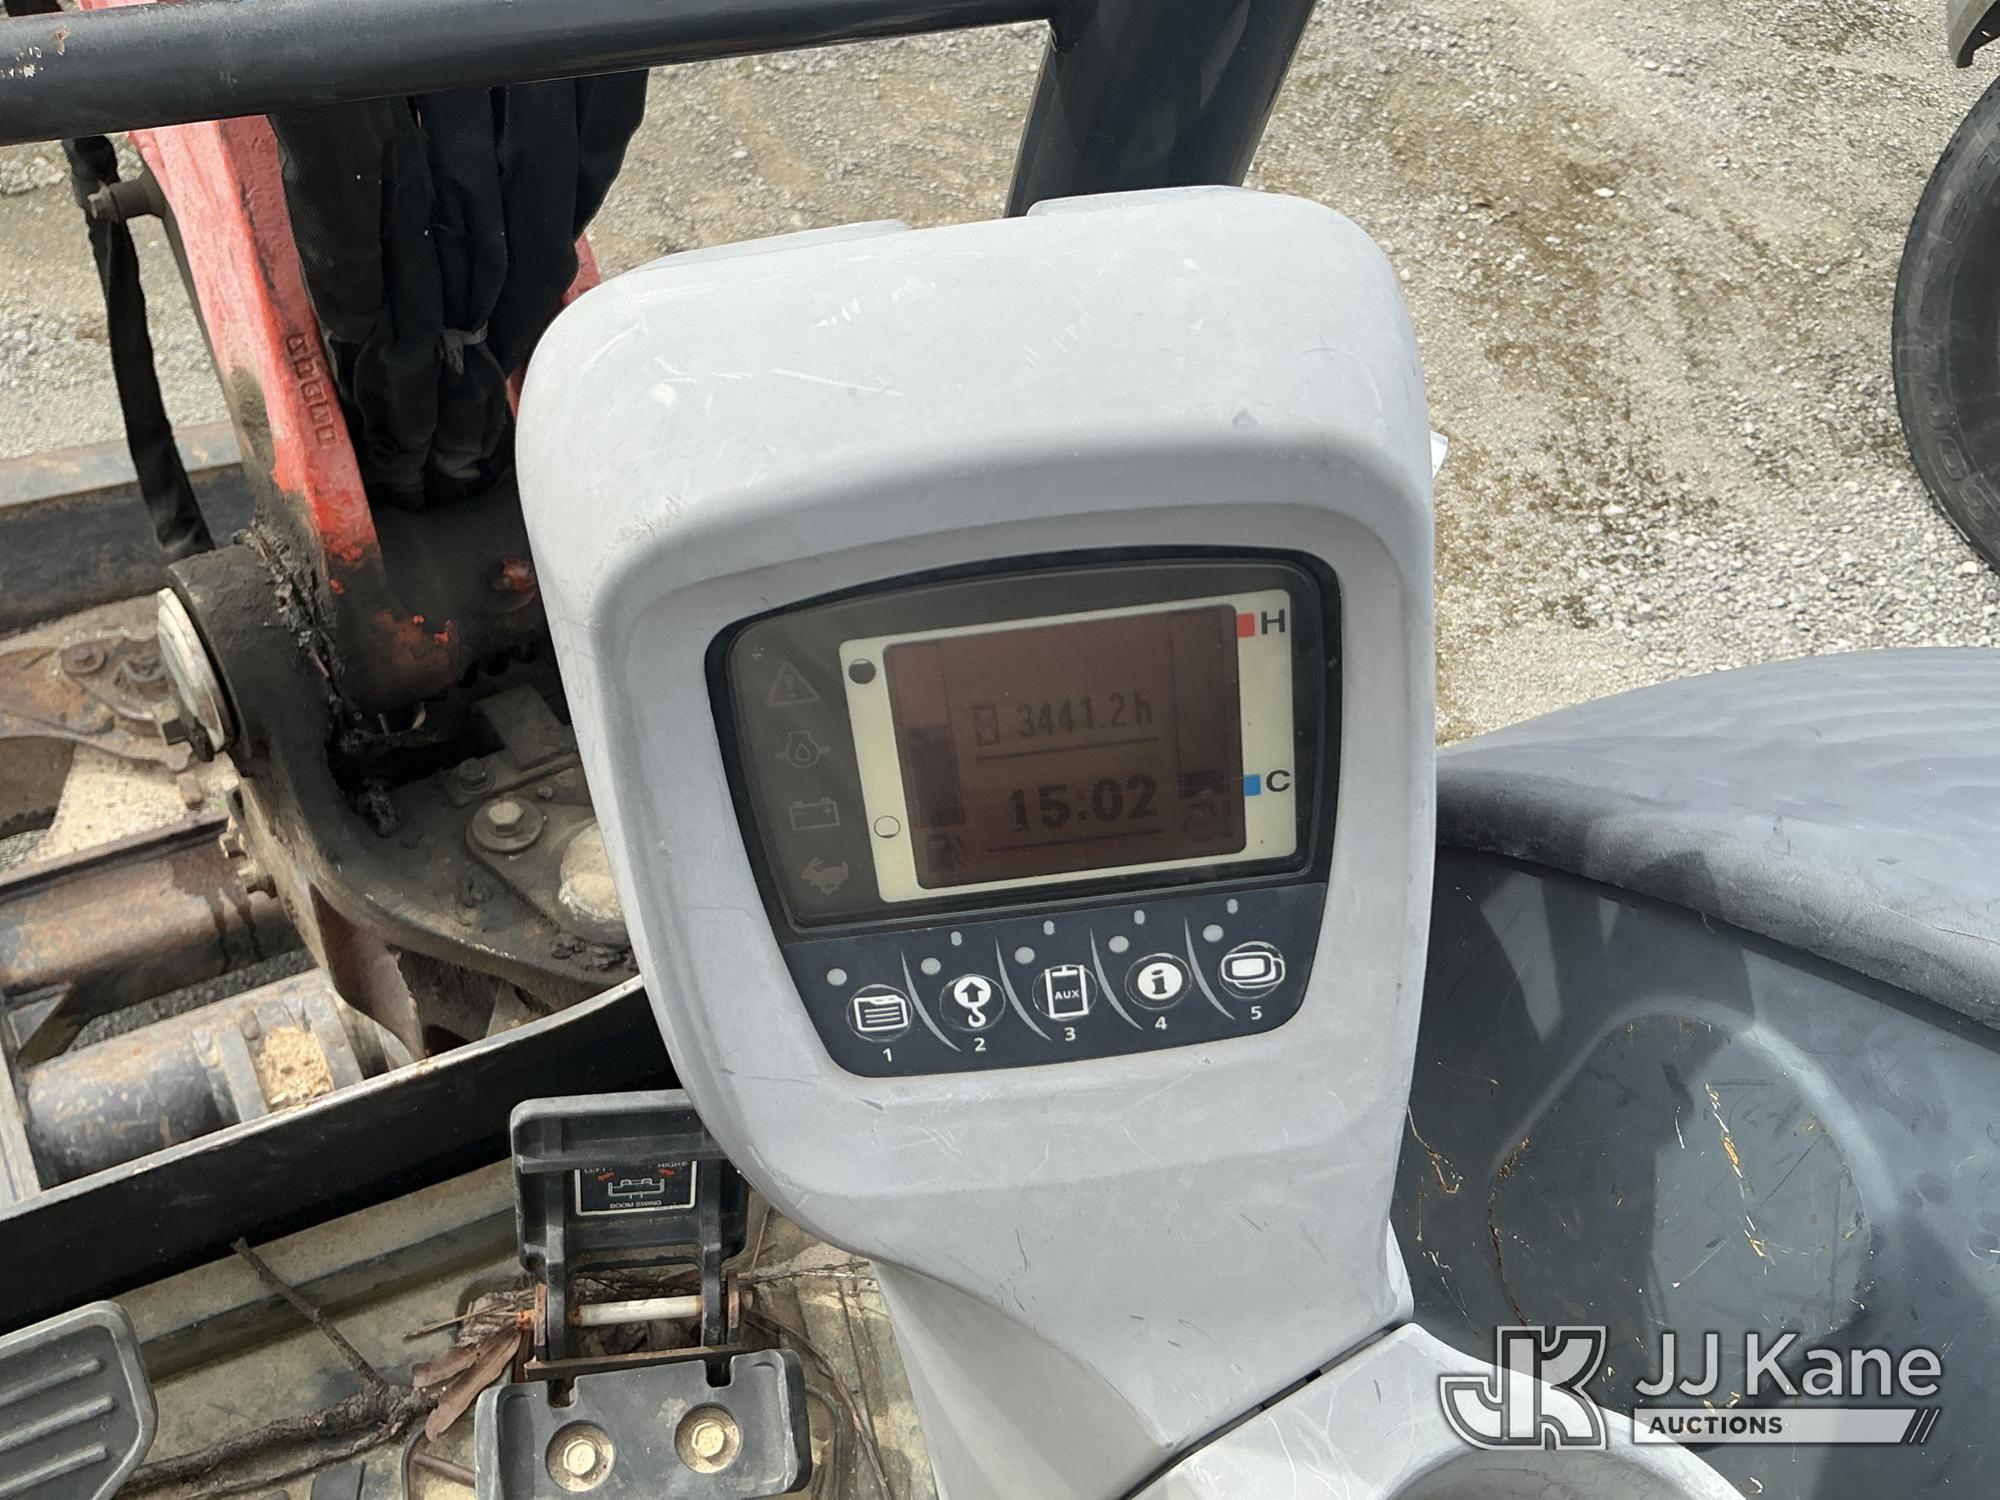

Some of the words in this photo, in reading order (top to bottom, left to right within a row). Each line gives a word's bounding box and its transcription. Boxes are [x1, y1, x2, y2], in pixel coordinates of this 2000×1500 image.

[1261, 609, 1286, 635] H
[1266, 769, 1290, 792] C
[1009, 775, 1157, 832] 15:02
[1054, 989, 1080, 1000] AUX
[1250, 1006, 1262, 1020] 5
[1155, 1016, 1168, 1030] 4
[1064, 1027, 1076, 1041] 3
[974, 1037, 986, 1051] 2
[882, 1048, 892, 1063] 1
